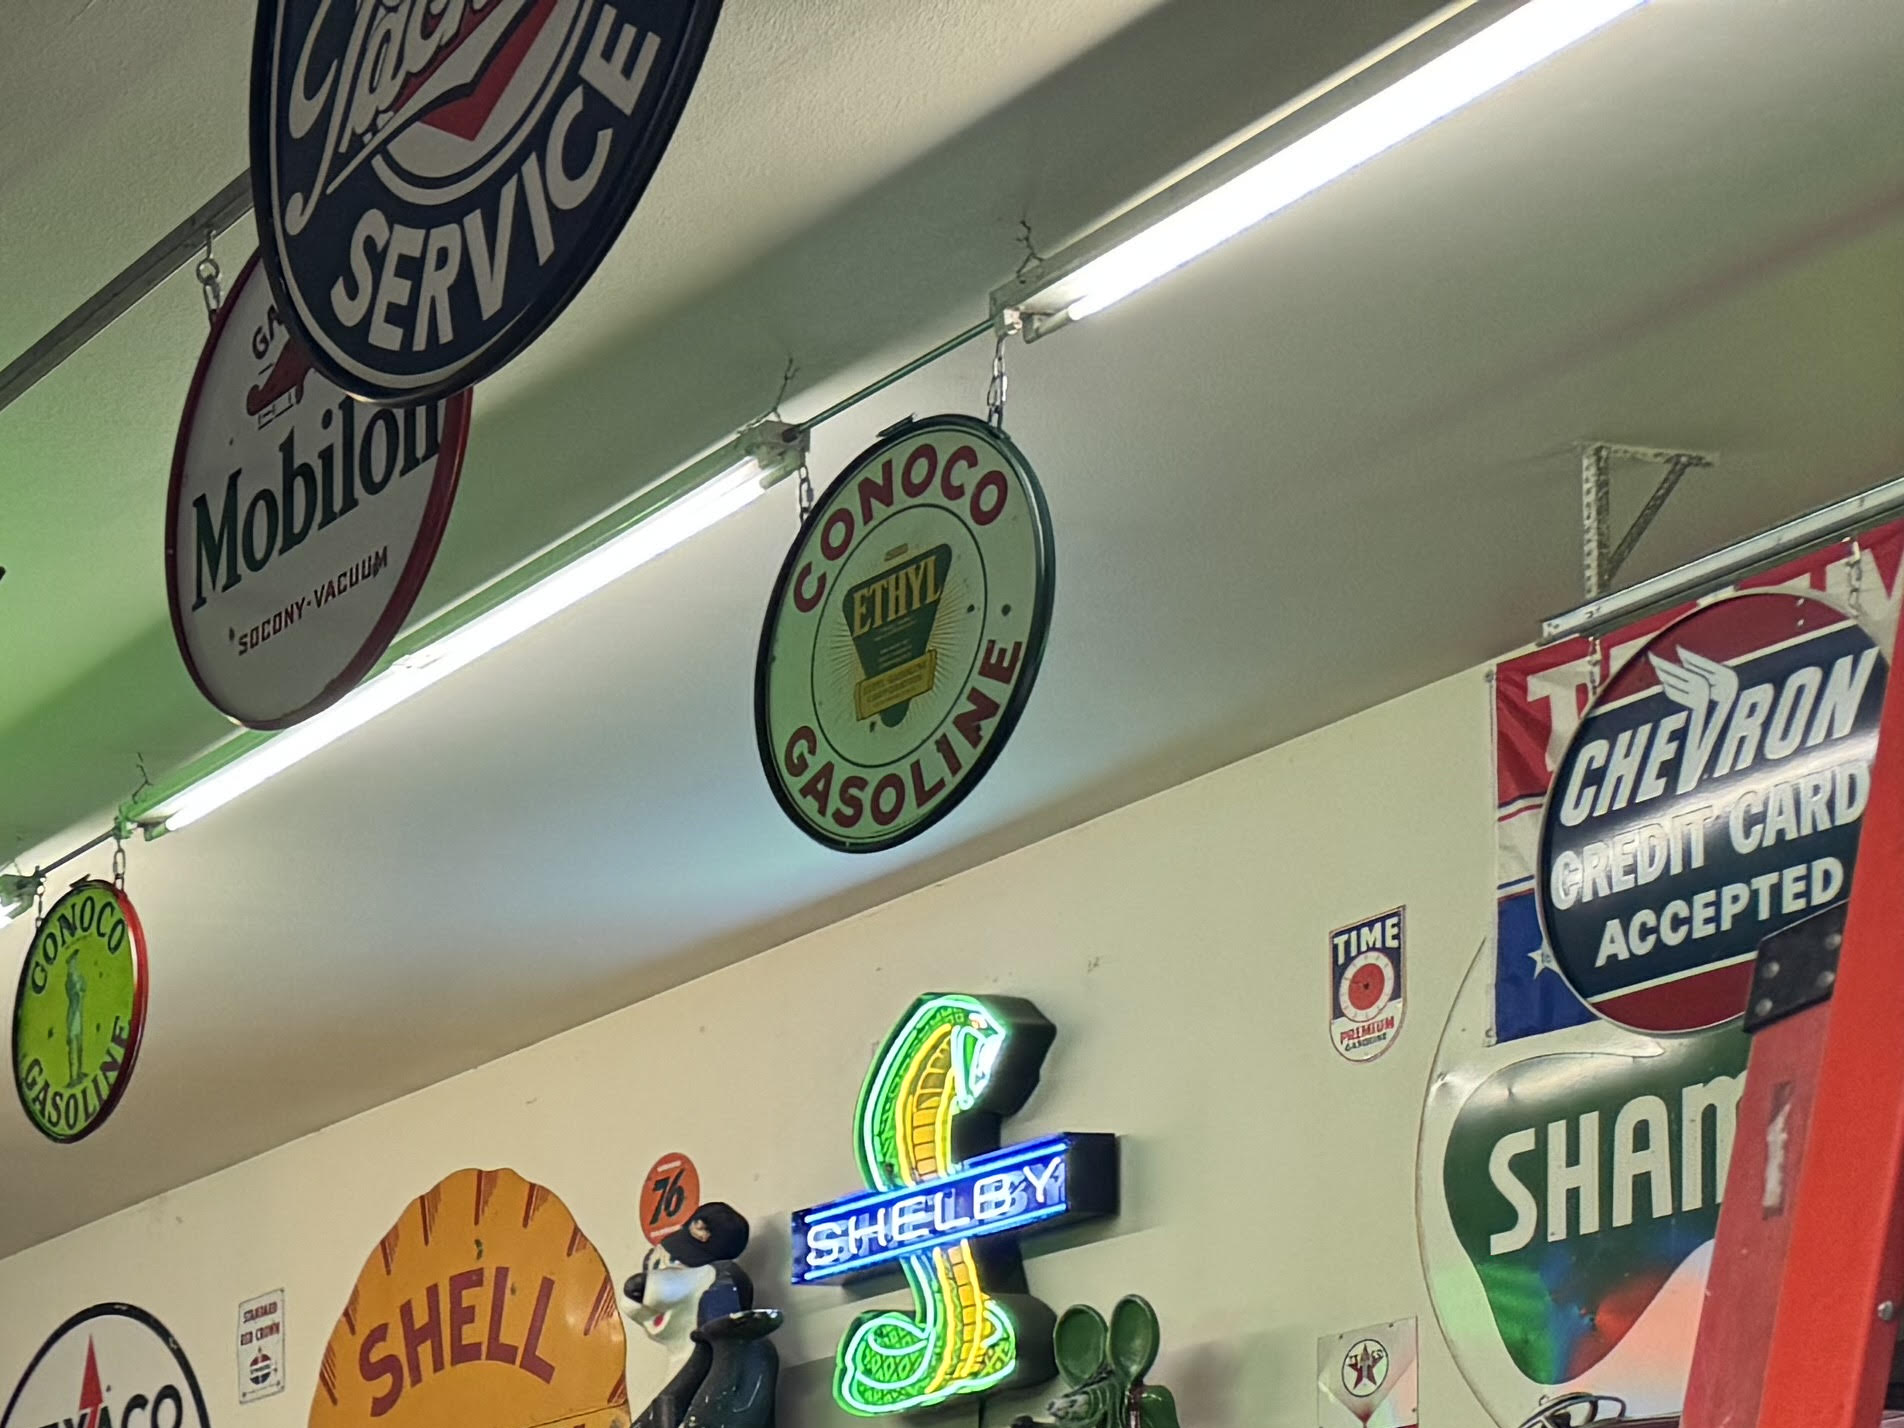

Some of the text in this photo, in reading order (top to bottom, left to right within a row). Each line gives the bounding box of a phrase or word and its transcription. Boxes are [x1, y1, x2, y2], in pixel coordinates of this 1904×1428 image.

[332, 2, 661, 352] SERVICE
[794, 443, 1008, 613] CONOCO
[851, 555, 942, 638] ETHYL
[784, 639, 1021, 829] GASOLINE
[1560, 646, 1879, 827] CHEVRON
[1551, 764, 1872, 912] CREDIT CARD
[30, 895, 127, 997] CONOCO
[1334, 917, 1398, 965] TIME
[1595, 858, 1843, 966] ACCEPTED
[22, 1014, 132, 1136] GASOLINE
[1340, 1016, 1394, 1044] PREMIUM
[649, 1168, 685, 1226] 76
[807, 1156, 1063, 1263] SHELBY
[255, 1322, 280, 1341] CROWN
[359, 1267, 556, 1418] SHELL
